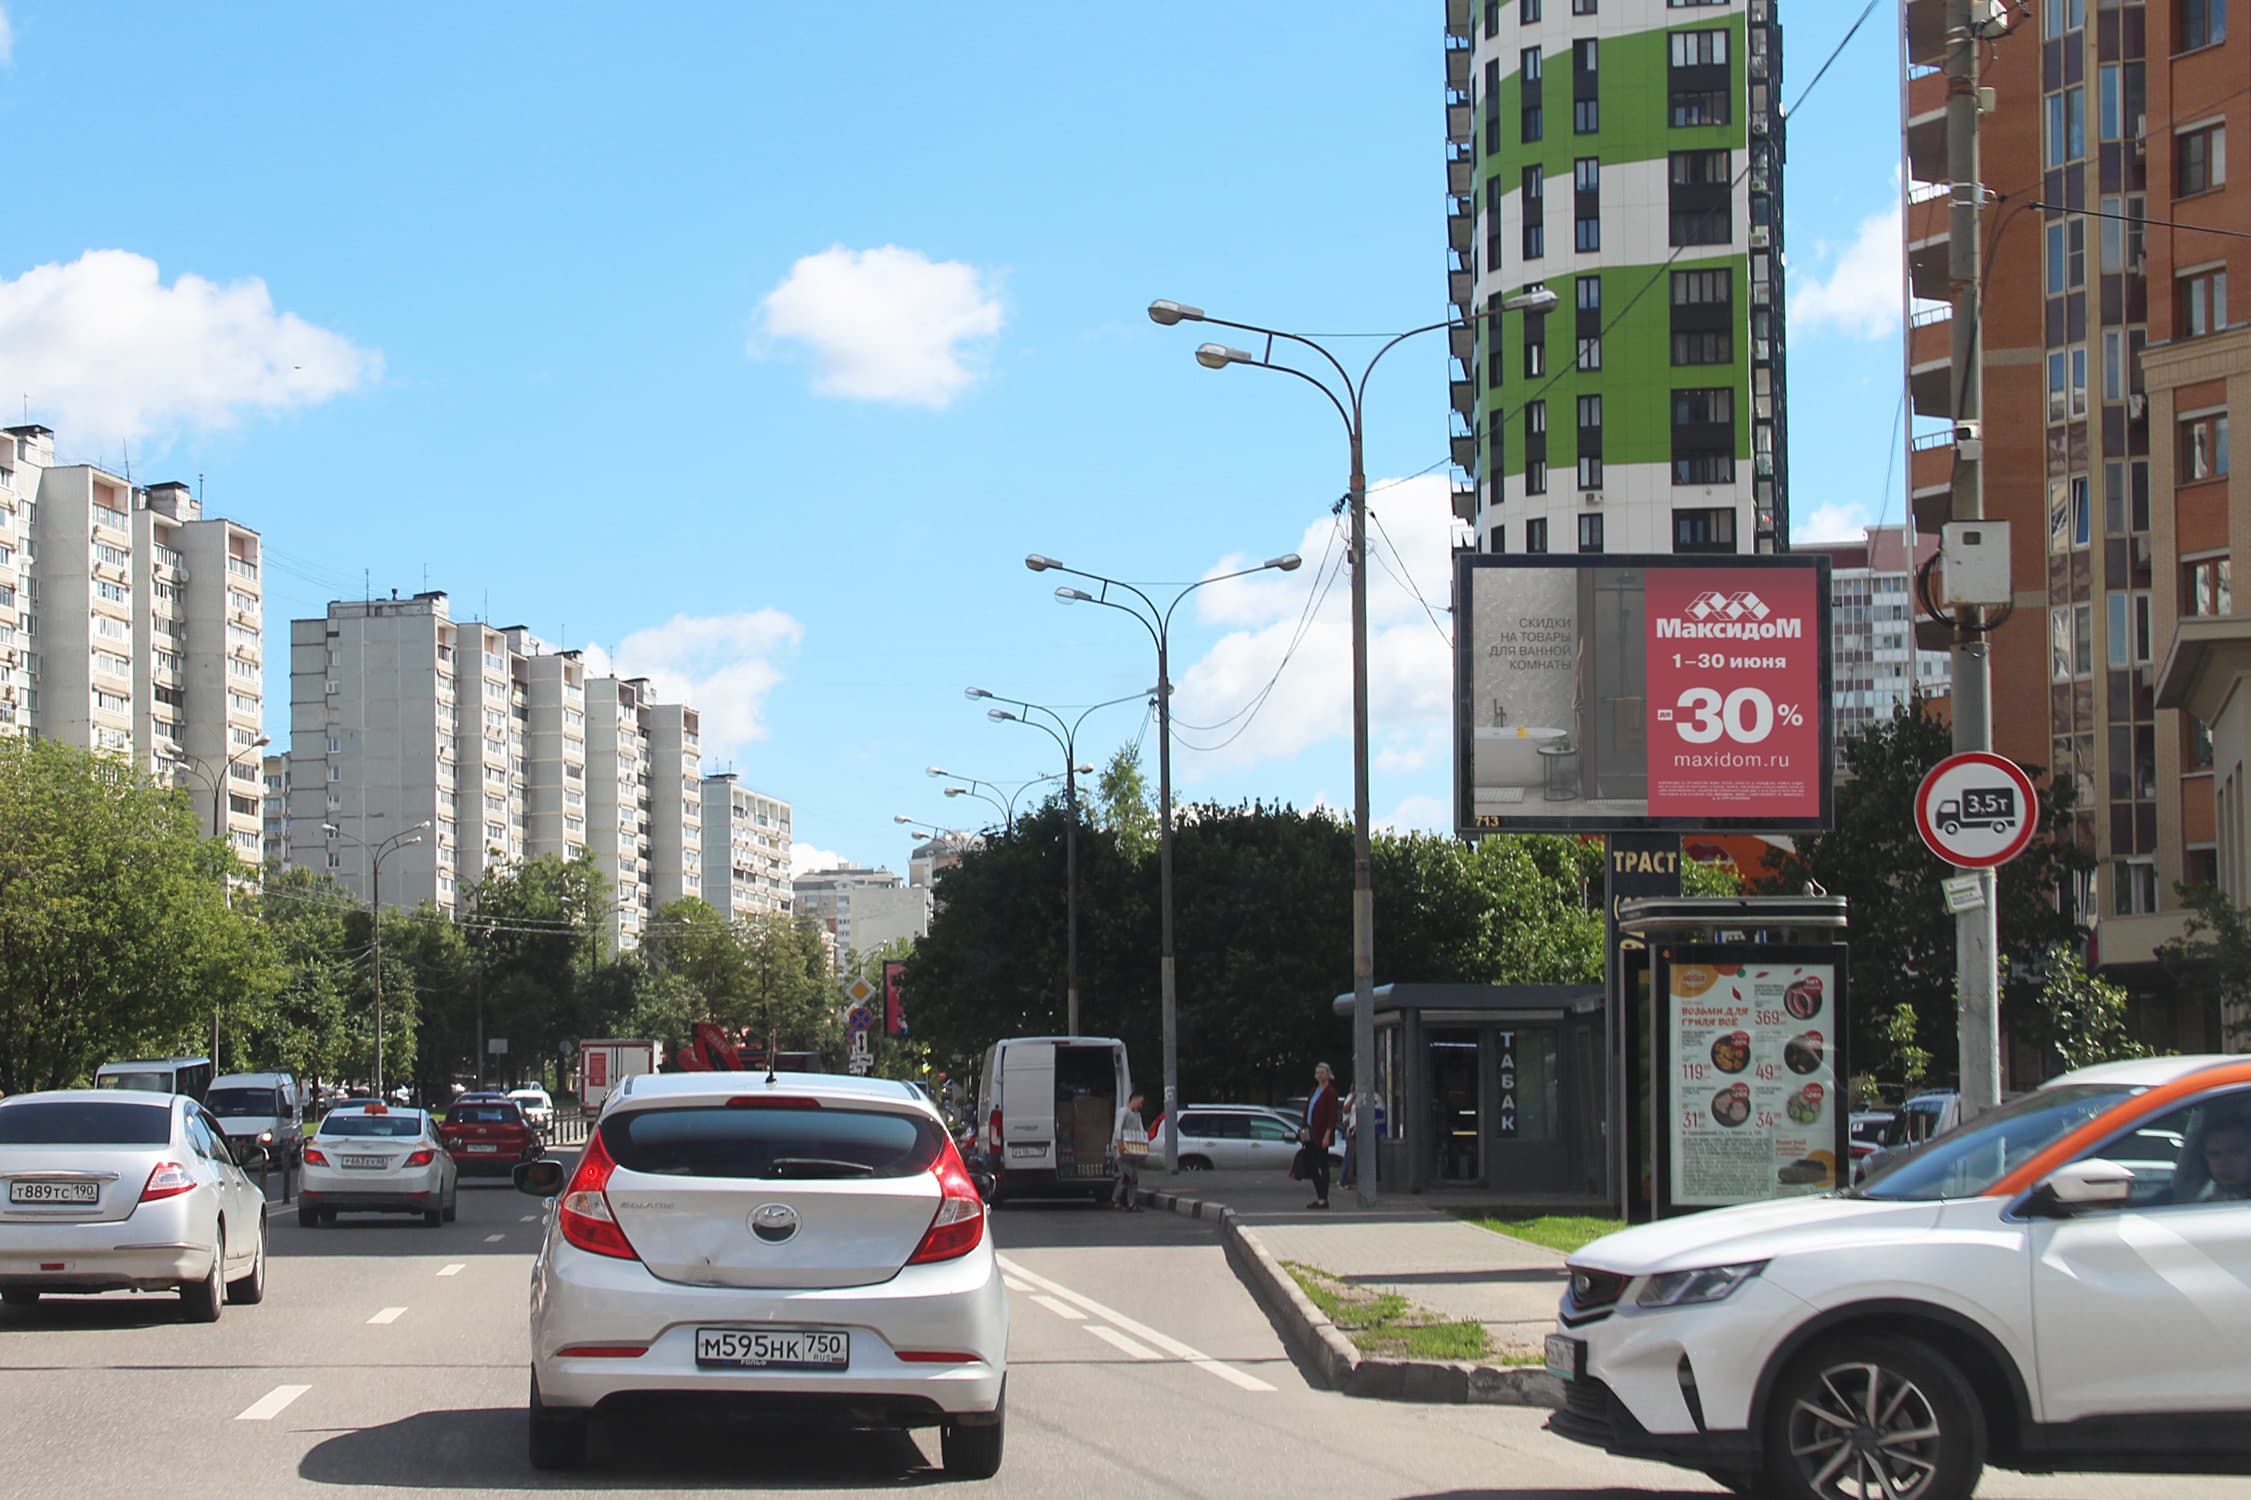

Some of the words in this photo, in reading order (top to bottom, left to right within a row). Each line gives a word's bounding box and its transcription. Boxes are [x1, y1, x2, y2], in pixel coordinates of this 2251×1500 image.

[1519, 617, 1571, 630] СКИДКИ
[1656, 618, 1801, 640] МаксидоМ
[1500, 632, 1517, 642] НА
[1520, 632, 1571, 642] ТОВАРЫ
[1489, 646, 1516, 657] ДЛЯ
[1519, 644, 1571, 657] ВАННОЙ
[1510, 660, 1571, 671] КОМНАТЫ
[1729, 656, 1786, 669] июня
[1674, 752, 1789, 768] maxidom.ru
[1476, 815, 1499, 827] 713
[1613, 851, 1677, 873] ТРАСТ
[1681, 1007, 1724, 1017] ВОЗЬМИ
[1726, 1007, 1749, 1017] ДЛЯ
[1755, 1010, 1780, 1025] 369
[1681, 1018, 1716, 1027] ГРИЛЯ
[1682, 1064, 1704, 1080] 119
[1755, 1064, 1774, 1080] 49
[1500, 1032, 1515, 1130] ТАБАК
[1682, 1112, 1697, 1128] 31
[1756, 1112, 1774, 1128] 34
[16, 1185, 70, 1199] Т889ТС
[74, 1185, 94, 1196] 190
[704, 1334, 799, 1359] М595НК
[805, 1335, 841, 1353] 750
[813, 1353, 832, 1361] RUS
